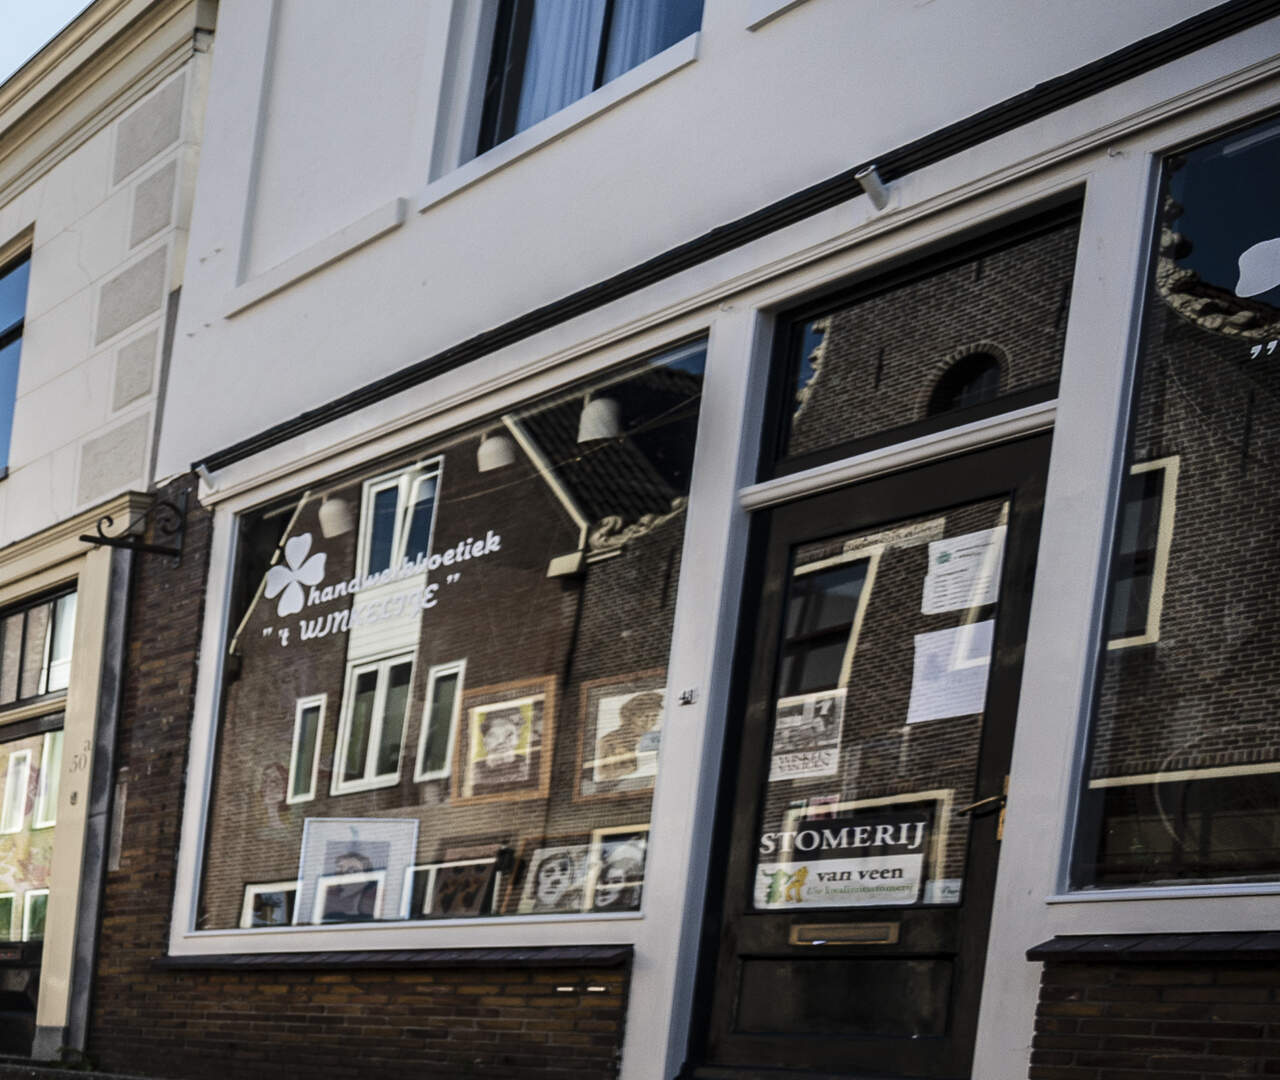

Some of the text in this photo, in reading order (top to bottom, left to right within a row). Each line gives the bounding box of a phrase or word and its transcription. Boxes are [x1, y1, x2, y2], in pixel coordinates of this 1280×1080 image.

[759, 822, 927, 854] STOMERIJ
[816, 867, 905, 883] van veen
